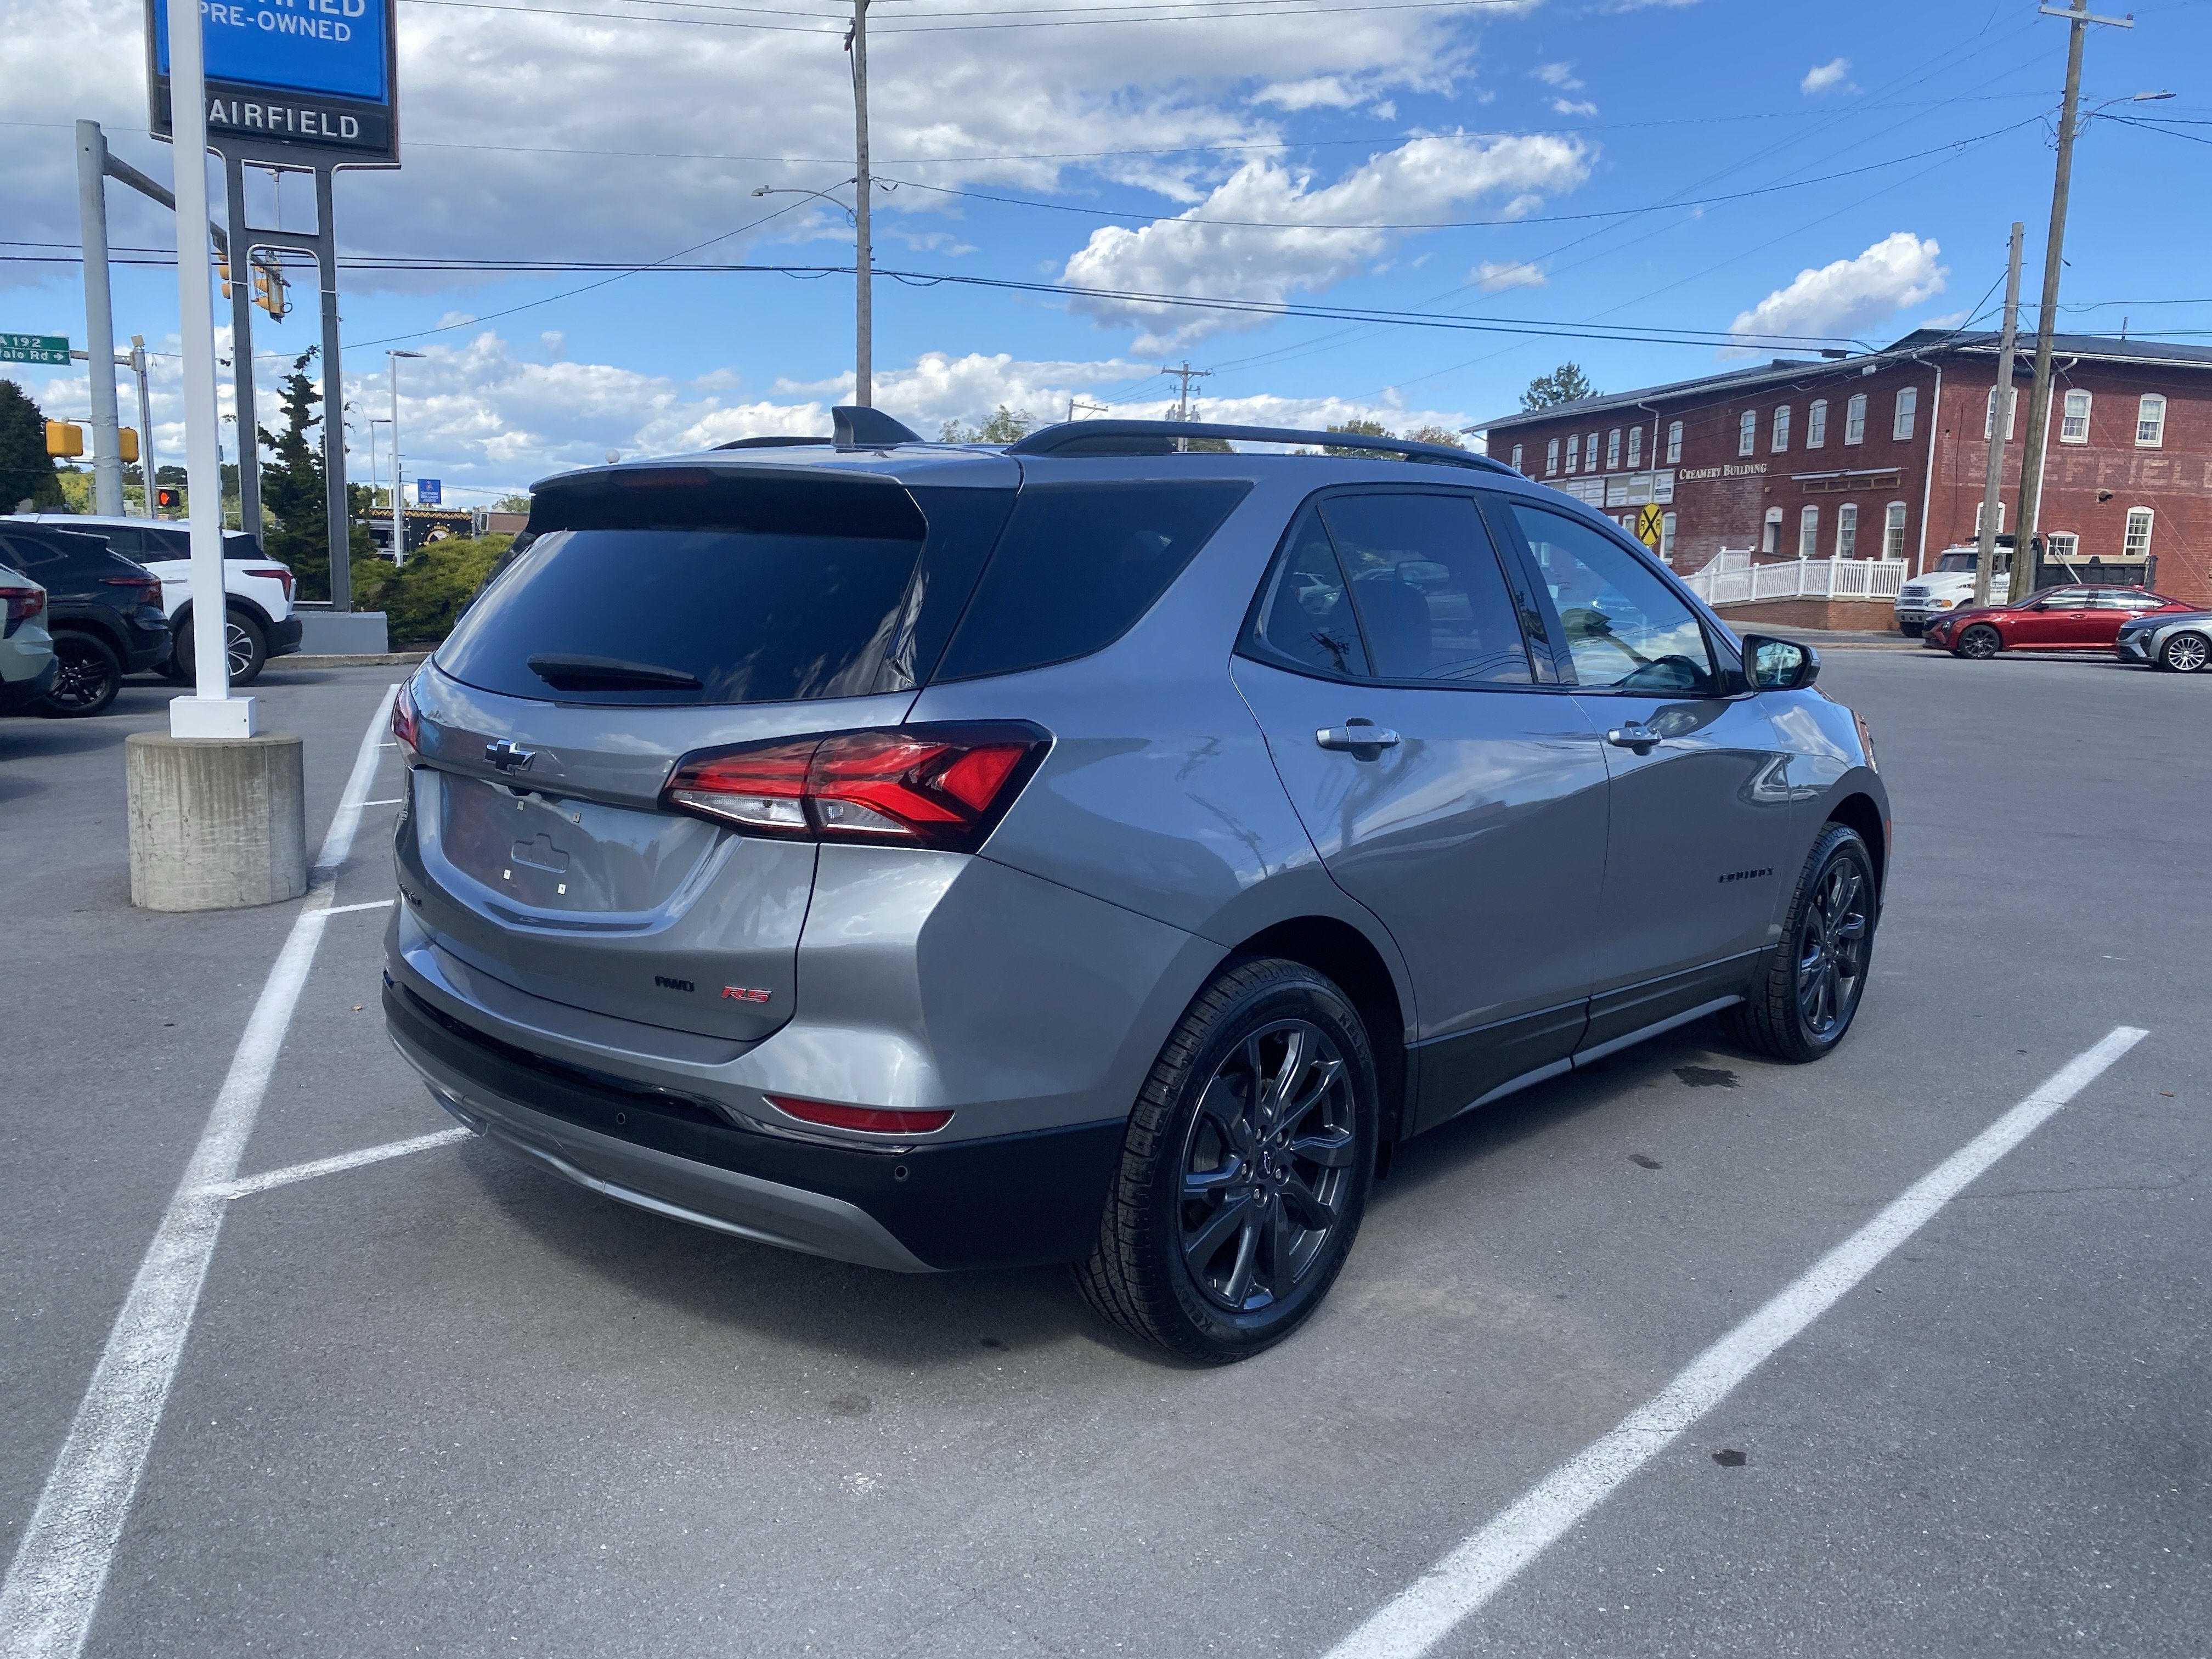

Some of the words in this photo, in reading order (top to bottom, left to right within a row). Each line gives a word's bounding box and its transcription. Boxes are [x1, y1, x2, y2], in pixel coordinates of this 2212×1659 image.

[205, 98, 359, 138] AIRFIELD
[13, 337, 41, 347] 192
[0, 349, 24, 359] alo
[30, 351, 48, 360] Rd
[1723, 463, 1767, 476] BUILDING
[1640, 520, 1645, 530] R
[1656, 519, 1660, 529] R
[721, 986, 773, 1003] RS
